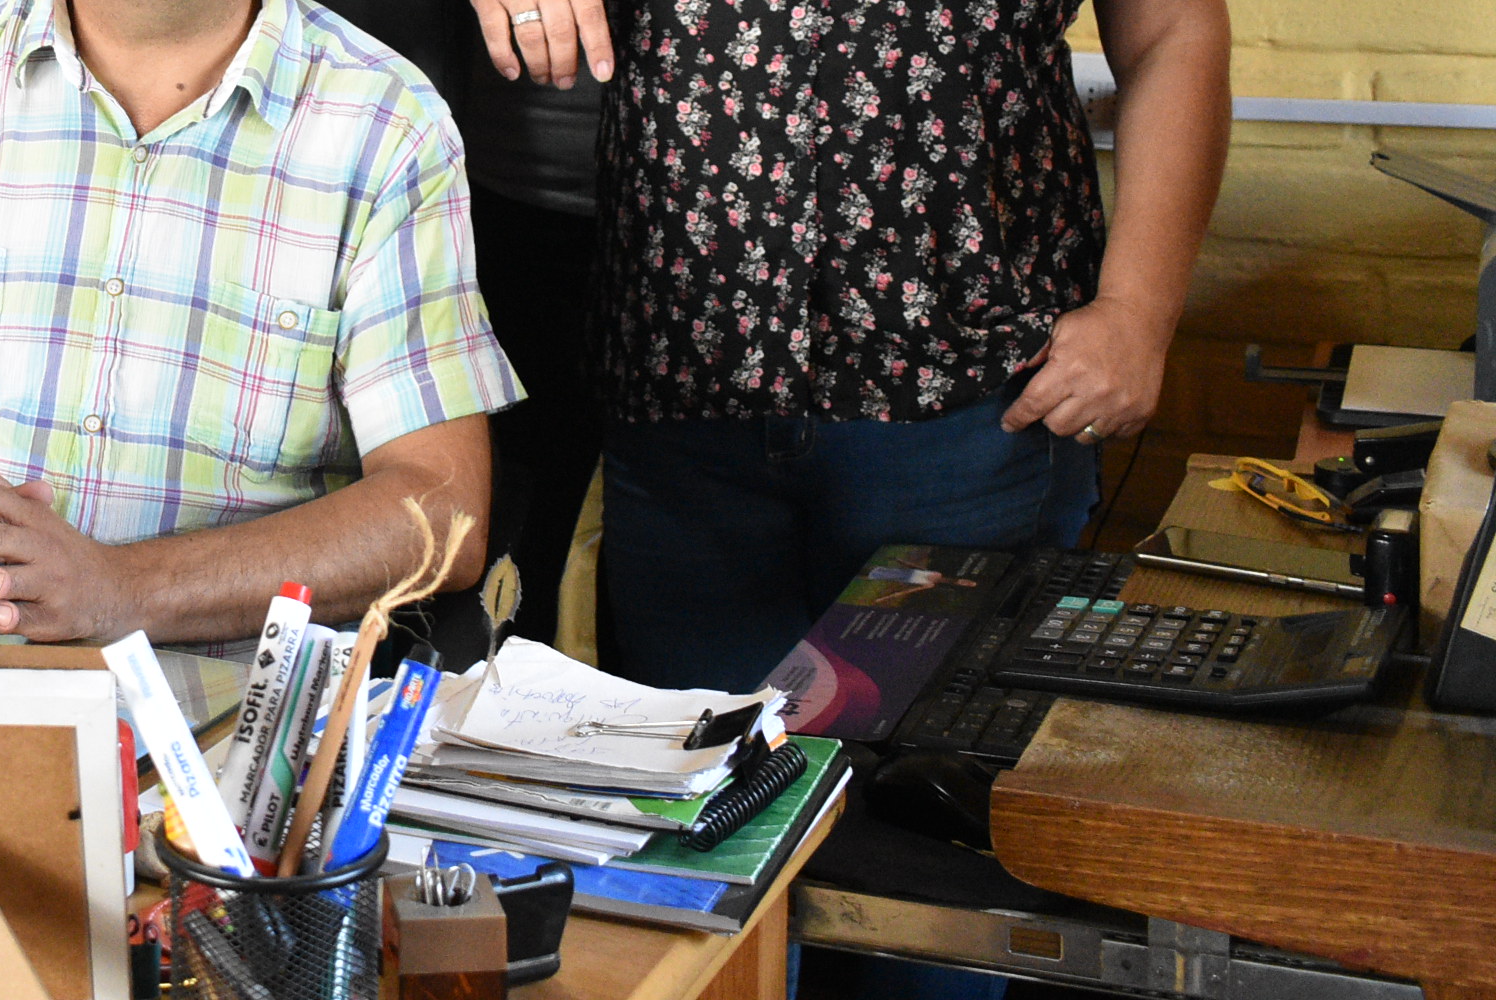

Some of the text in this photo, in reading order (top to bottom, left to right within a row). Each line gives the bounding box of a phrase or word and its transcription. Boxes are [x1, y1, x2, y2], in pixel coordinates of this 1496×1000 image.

[240, 726, 272, 804] MARCADOR
[264, 682, 285, 724] PARA
[277, 629, 299, 683] PIZARRA
[262, 793, 283, 834] PILOT
[360, 754, 389, 811] Marcador
[369, 755, 408, 827] Pizarra
